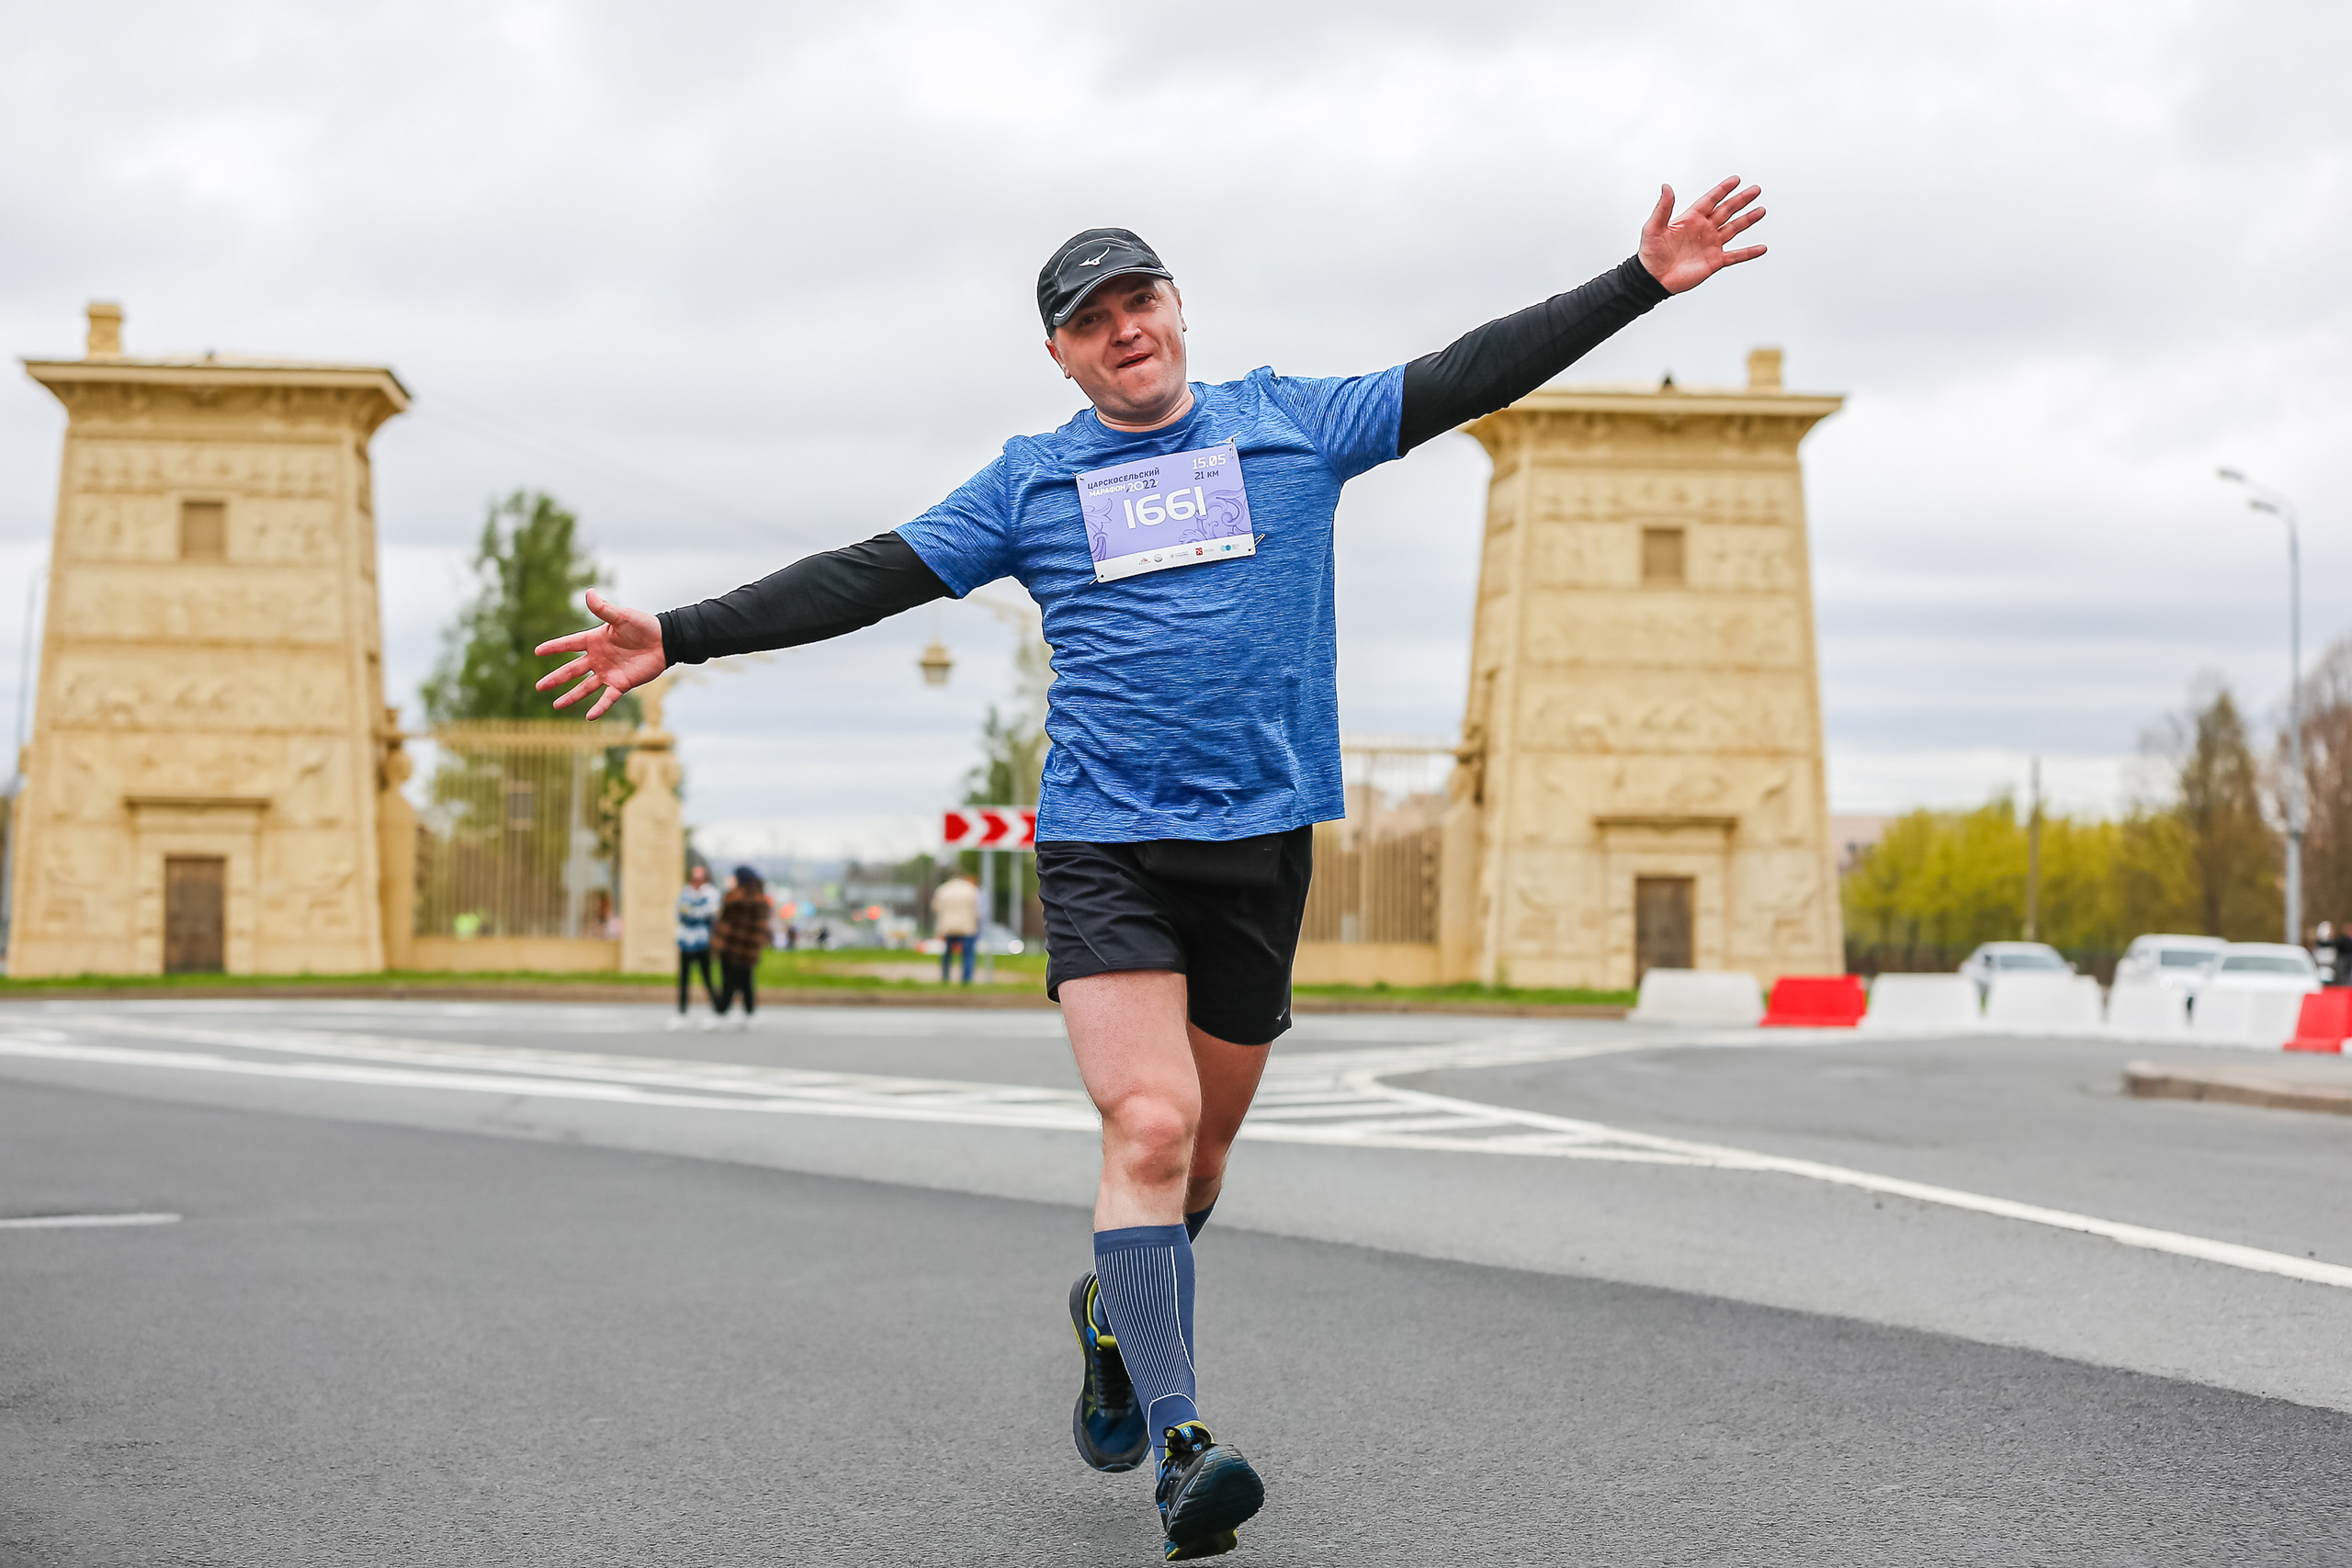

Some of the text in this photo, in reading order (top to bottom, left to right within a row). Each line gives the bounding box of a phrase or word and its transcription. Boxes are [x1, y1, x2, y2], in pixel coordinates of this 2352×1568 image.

[1192, 453, 1227, 470] 15.05
[1087, 467, 1159, 489] ЦАРСКОСЕЛЬСКИЙ
[1194, 471, 1204, 480] 21
[1089, 479, 1158, 497] МАРАФОН 2022
[1123, 486, 1207, 529] 1661
